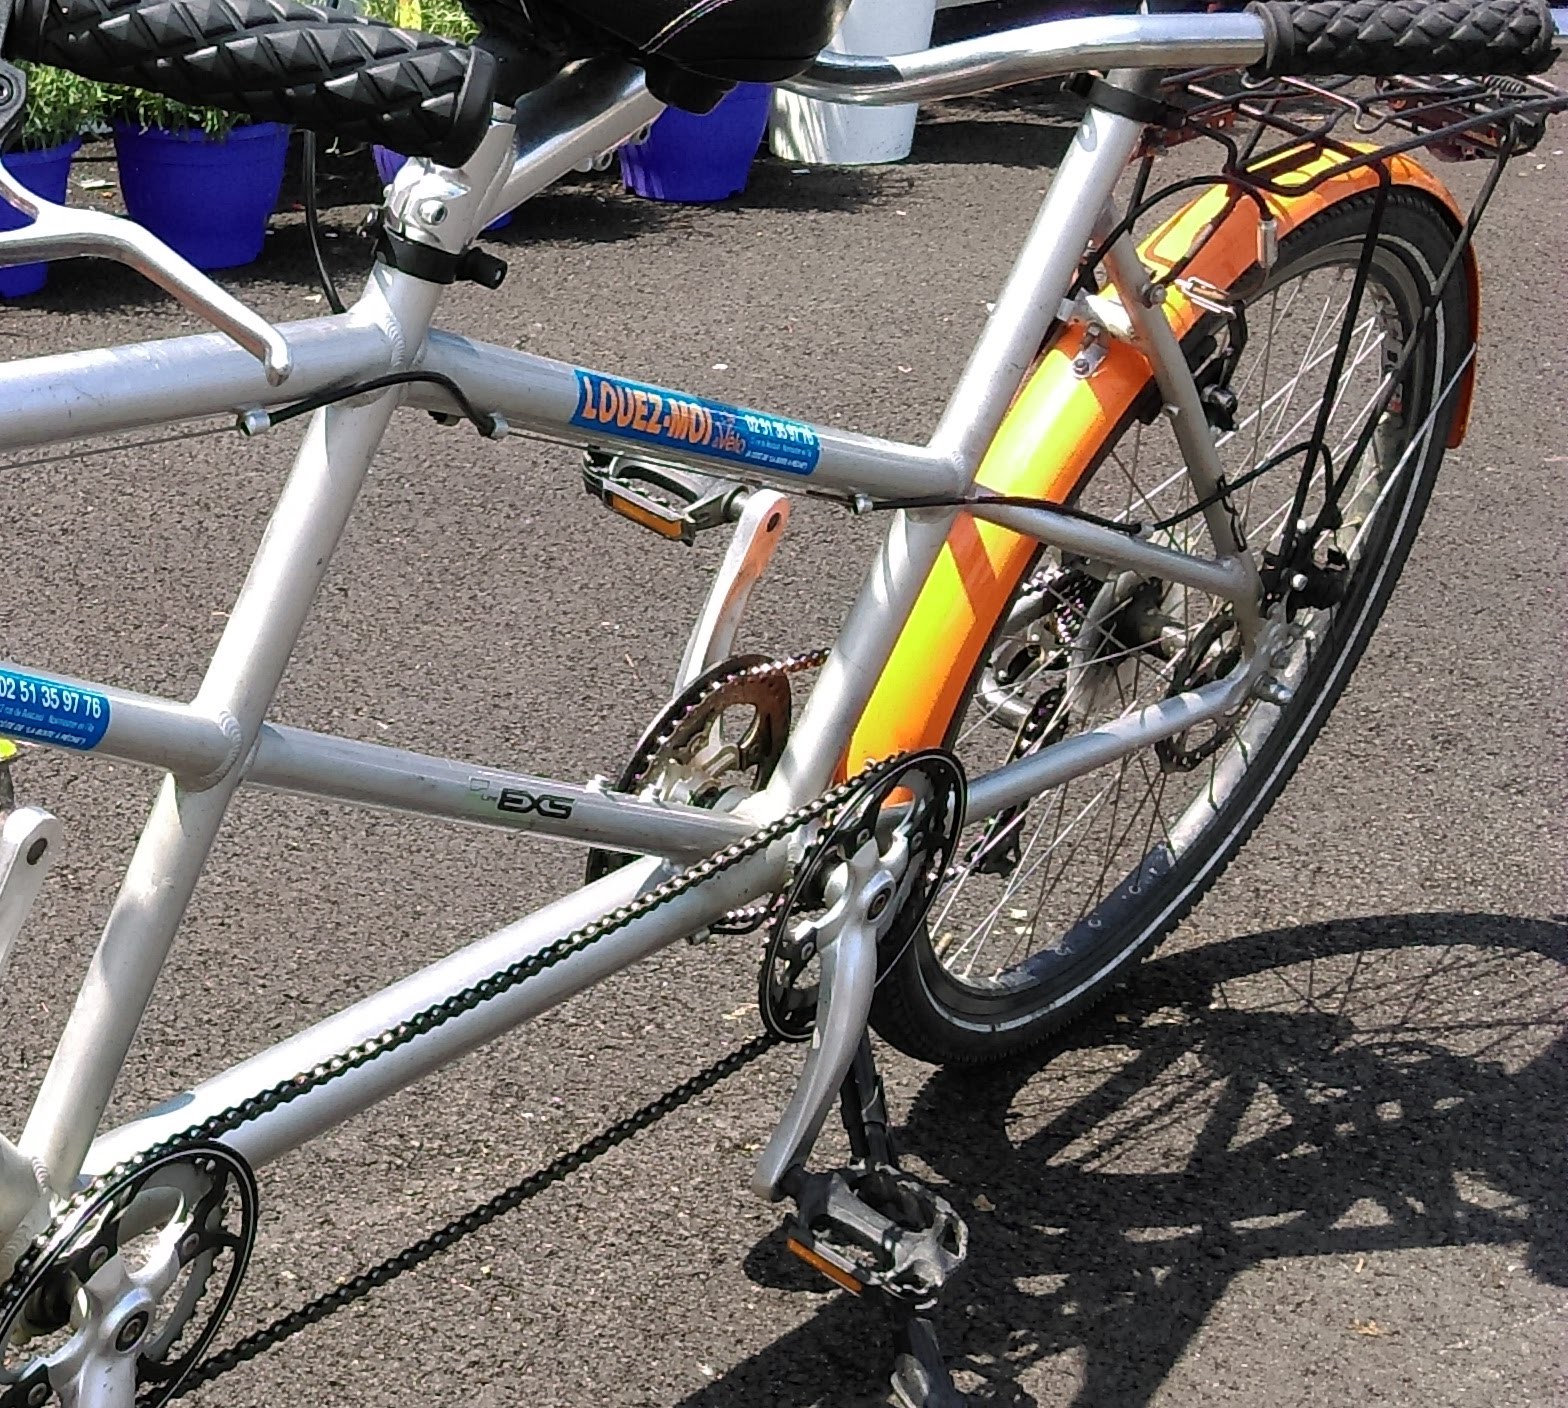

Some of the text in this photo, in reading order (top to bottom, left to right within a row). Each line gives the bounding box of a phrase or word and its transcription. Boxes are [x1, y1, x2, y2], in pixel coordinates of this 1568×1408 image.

[582, 376, 713, 445] LOUEZ-MOI
[20, 680, 36, 704] 51
[41, 686, 60, 710] 35
[63, 691, 79, 713] 97
[83, 695, 101, 719] 76
[497, 787, 576, 819] EXS
